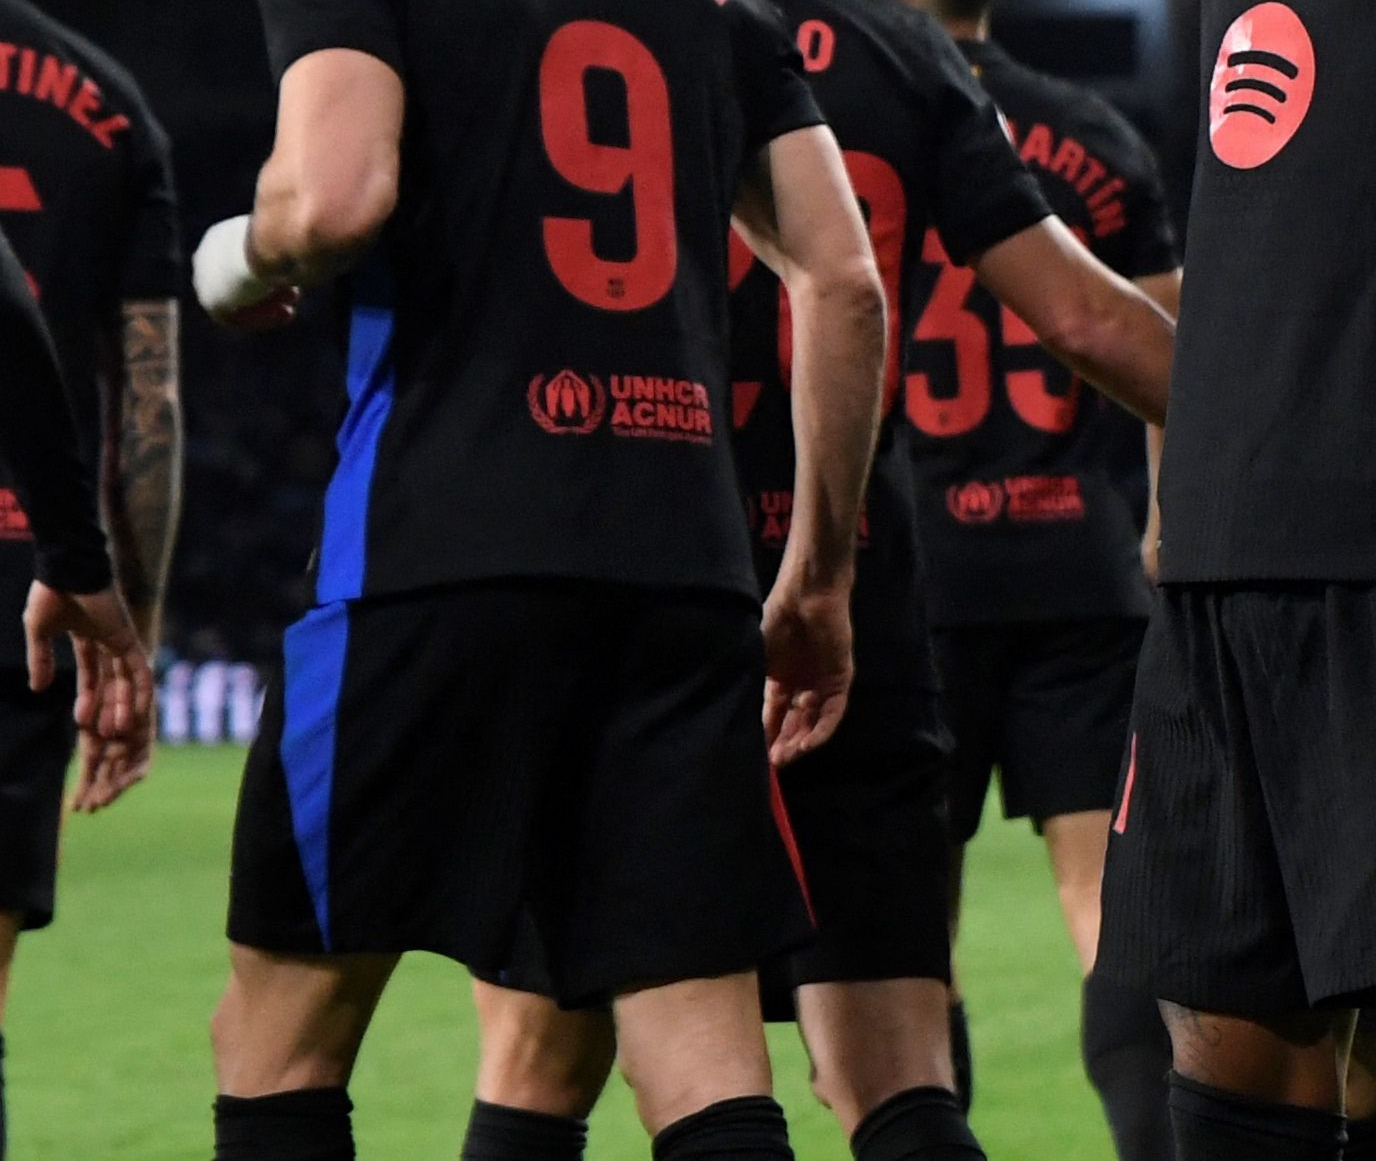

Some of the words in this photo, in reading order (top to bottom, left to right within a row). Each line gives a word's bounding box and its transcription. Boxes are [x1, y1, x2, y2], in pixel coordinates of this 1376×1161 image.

[538, 19, 679, 312] 9
[609, 374, 710, 409] UNHCR
[611, 401, 713, 435] ACNUR
